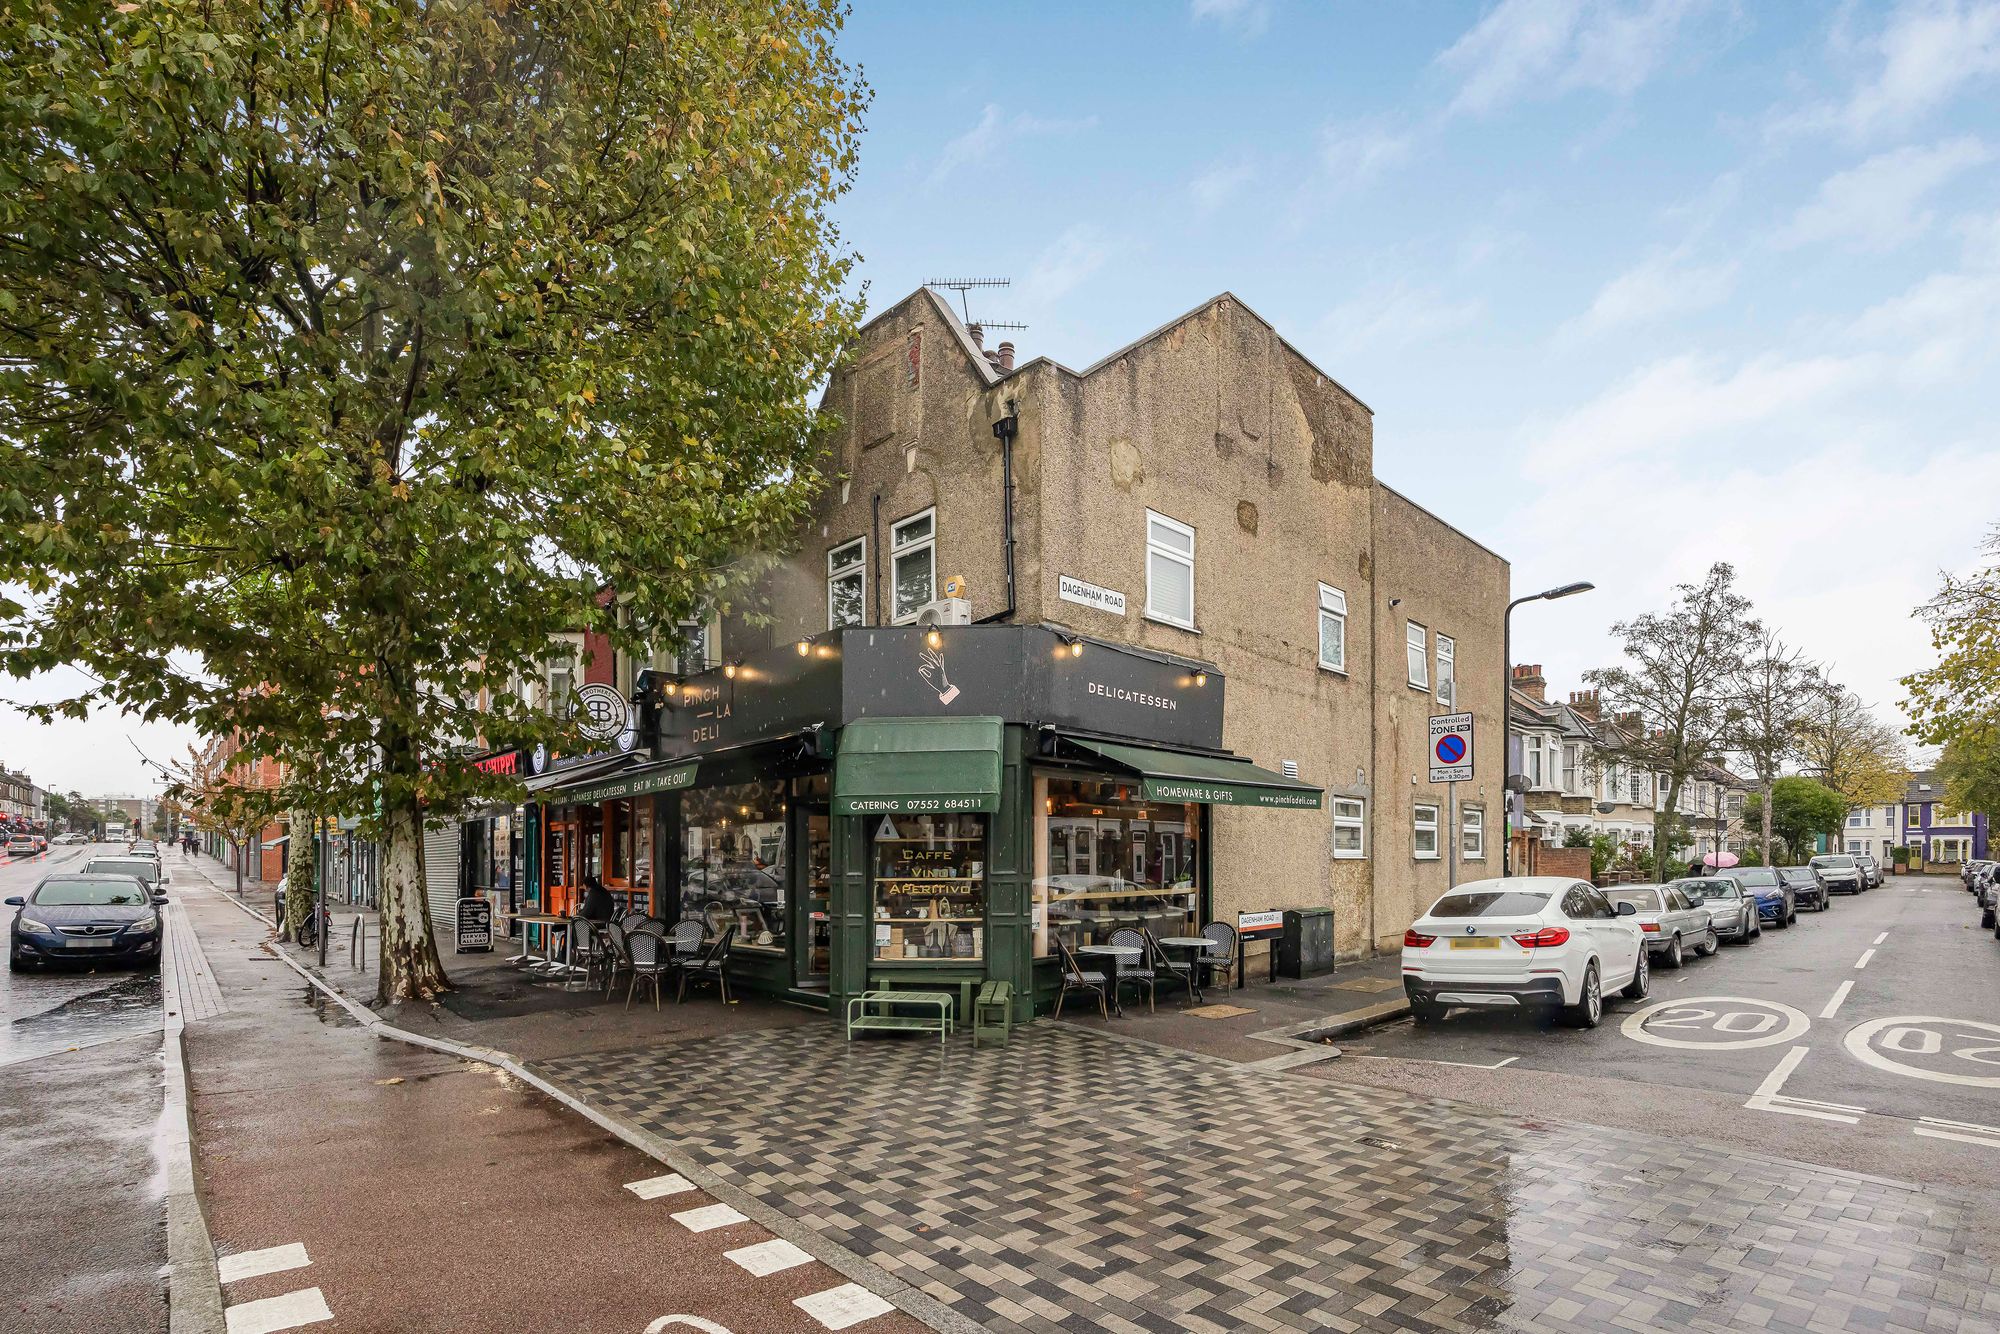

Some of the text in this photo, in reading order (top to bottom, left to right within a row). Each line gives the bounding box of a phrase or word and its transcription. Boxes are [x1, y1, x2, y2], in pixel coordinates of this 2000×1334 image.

[1062, 582, 1102, 602] DAGENHAM
[1104, 594, 1123, 608] ROAD
[582, 688, 611, 698] BROTHERS
[683, 685, 719, 708] PINCH
[1088, 682, 1177, 711] DELICATESSEN
[716, 703, 731, 719] LA
[1431, 716, 1469, 725] Controlled
[692, 723, 719, 743] DELI
[1431, 726, 1455, 735] ZONE
[633, 782, 644, 792] EAT
[644, 780, 651, 790] IN
[657, 775, 672, 788] TAKE
[673, 772, 687, 785] OUT
[571, 791, 592, 803] JAPANESE
[593, 784, 627, 799] DELICATESSEN
[1156, 786, 1233, 801] HOMEWARE & GIFTS
[1259, 794, 1317, 806] www.pinchladeli.com
[850, 799, 982, 810] CATERING 07552 684511
[911, 868, 948, 878] VINO
[889, 884, 971, 894] APERITIVO
[1241, 914, 1275, 924] DAGENHAM ROAD
[1645, 1008, 1782, 1034] 20
